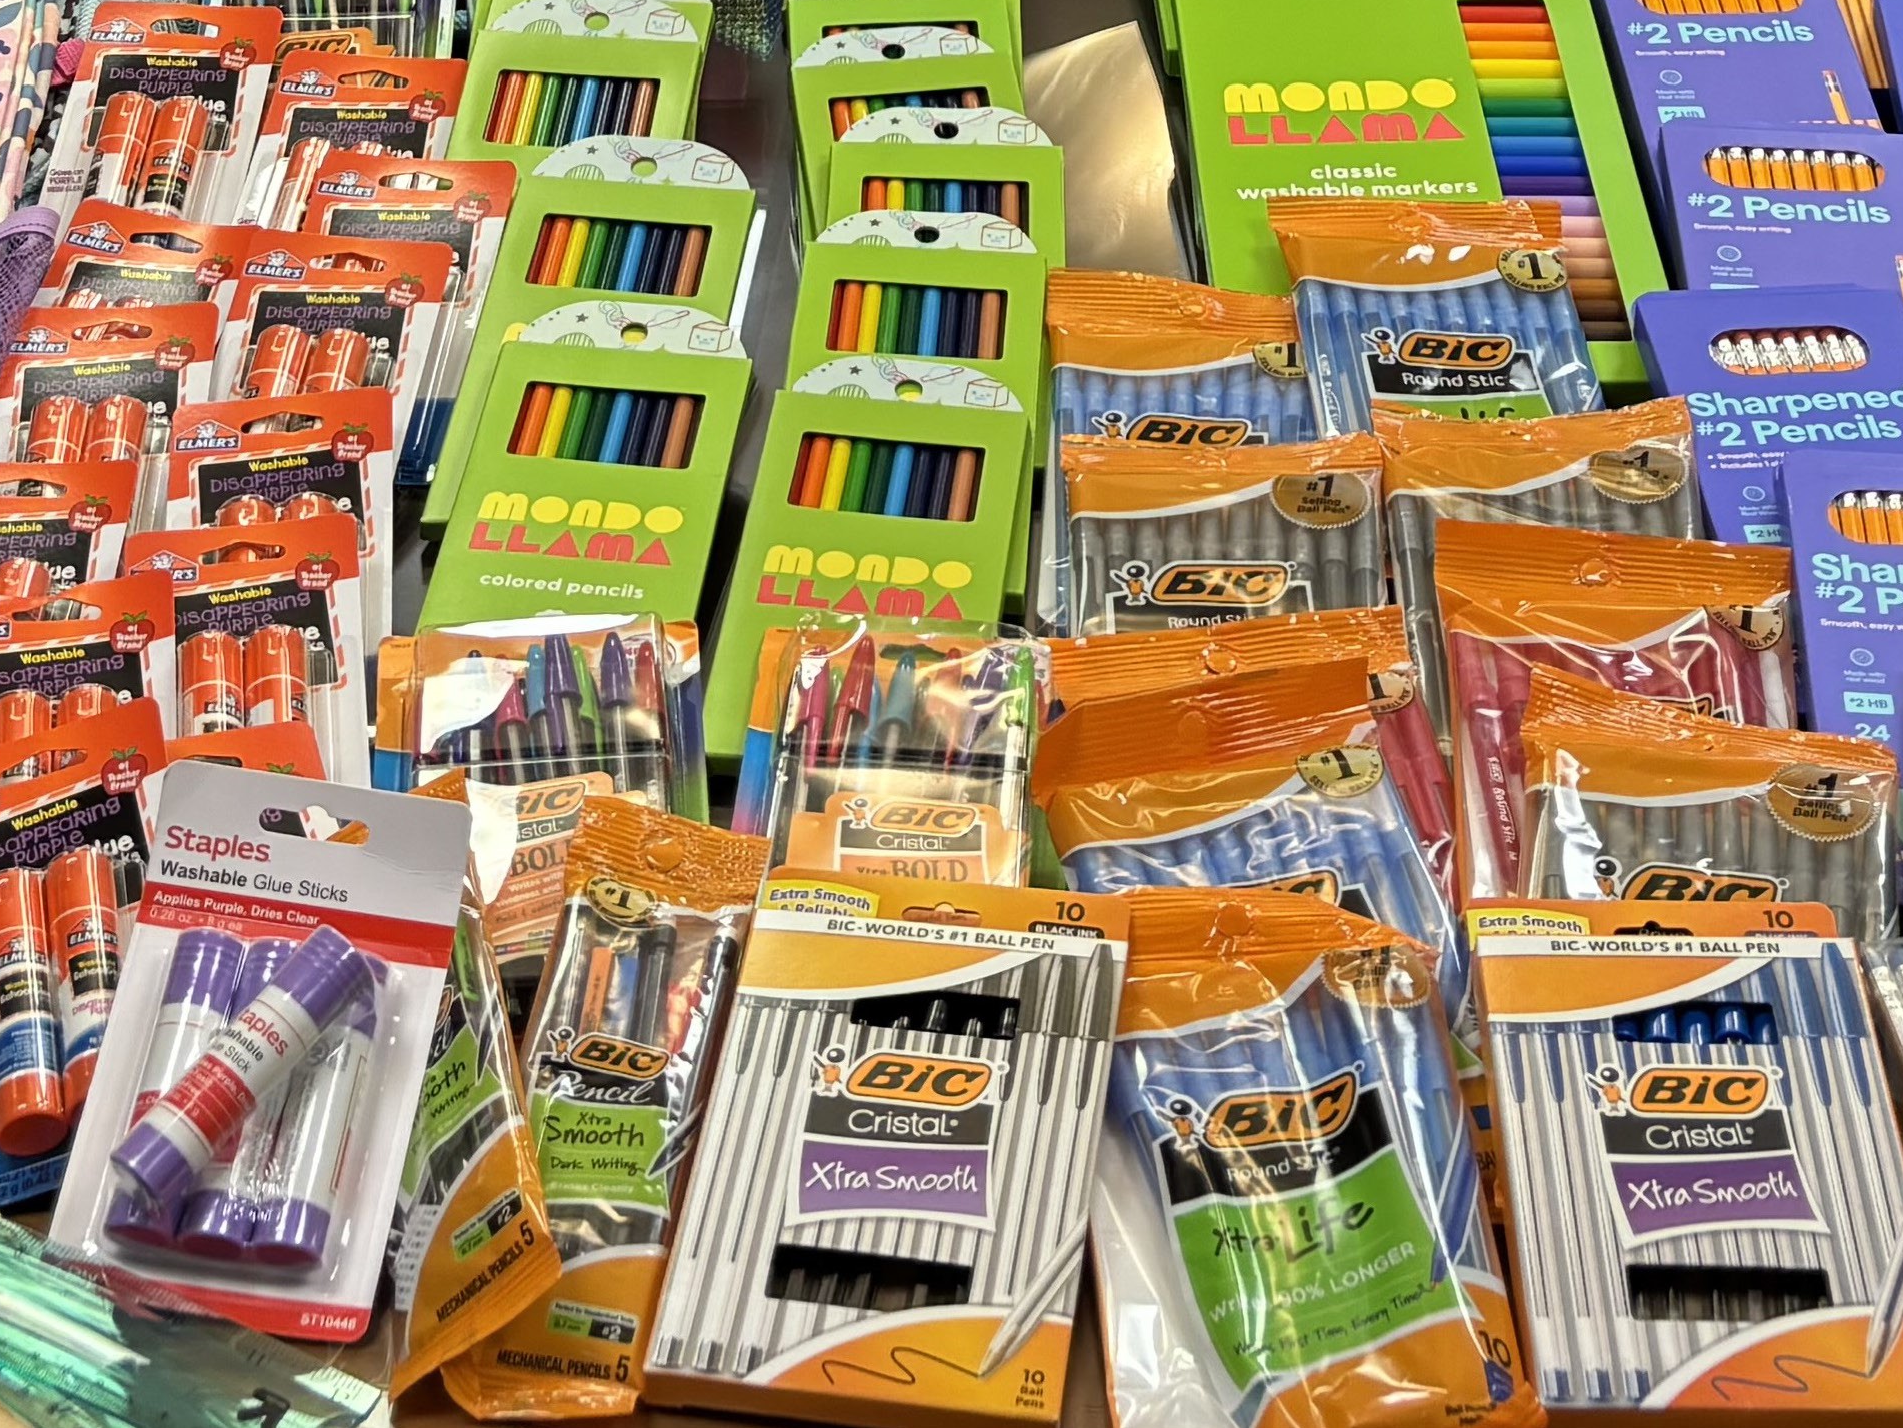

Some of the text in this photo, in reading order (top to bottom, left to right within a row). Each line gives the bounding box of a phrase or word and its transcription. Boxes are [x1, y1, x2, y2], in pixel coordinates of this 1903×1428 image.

[1223, 78, 1456, 113] MONDO
[1227, 112, 1465, 144] LLAMA
[1372, 179, 1479, 198] markers
[1402, 373, 1505, 389] Round Stic
[1695, 416, 1903, 446] #2 Pencils
[478, 492, 684, 533] MONDO
[469, 522, 673, 566] LLAMA
[480, 573, 643, 602] colored pencils
[1815, 583, 1866, 614] #2
[166, 823, 271, 863] Staples
[160, 859, 349, 903] Washable Glue Sticks
[154, 891, 201, 912] Applies
[251, 905, 283, 921] Dries
[287, 910, 320, 926] Clear
[1761, 910, 1794, 928] 10
[947, 926, 970, 942] #1
[974, 930, 1018, 947] BALL
[1020, 932, 1055, 951] PEN
[1673, 940, 1693, 956] #1
[1698, 941, 1740, 956] BALL
[1745, 941, 1781, 956] PEN
[543, 1117, 646, 1148] Smooth
[578, 1111, 612, 1127] Xtra
[806, 1161, 978, 1195] Xtra Smooth
[567, 1359, 612, 1379] PENCILS
[615, 1356, 629, 1381] 5
